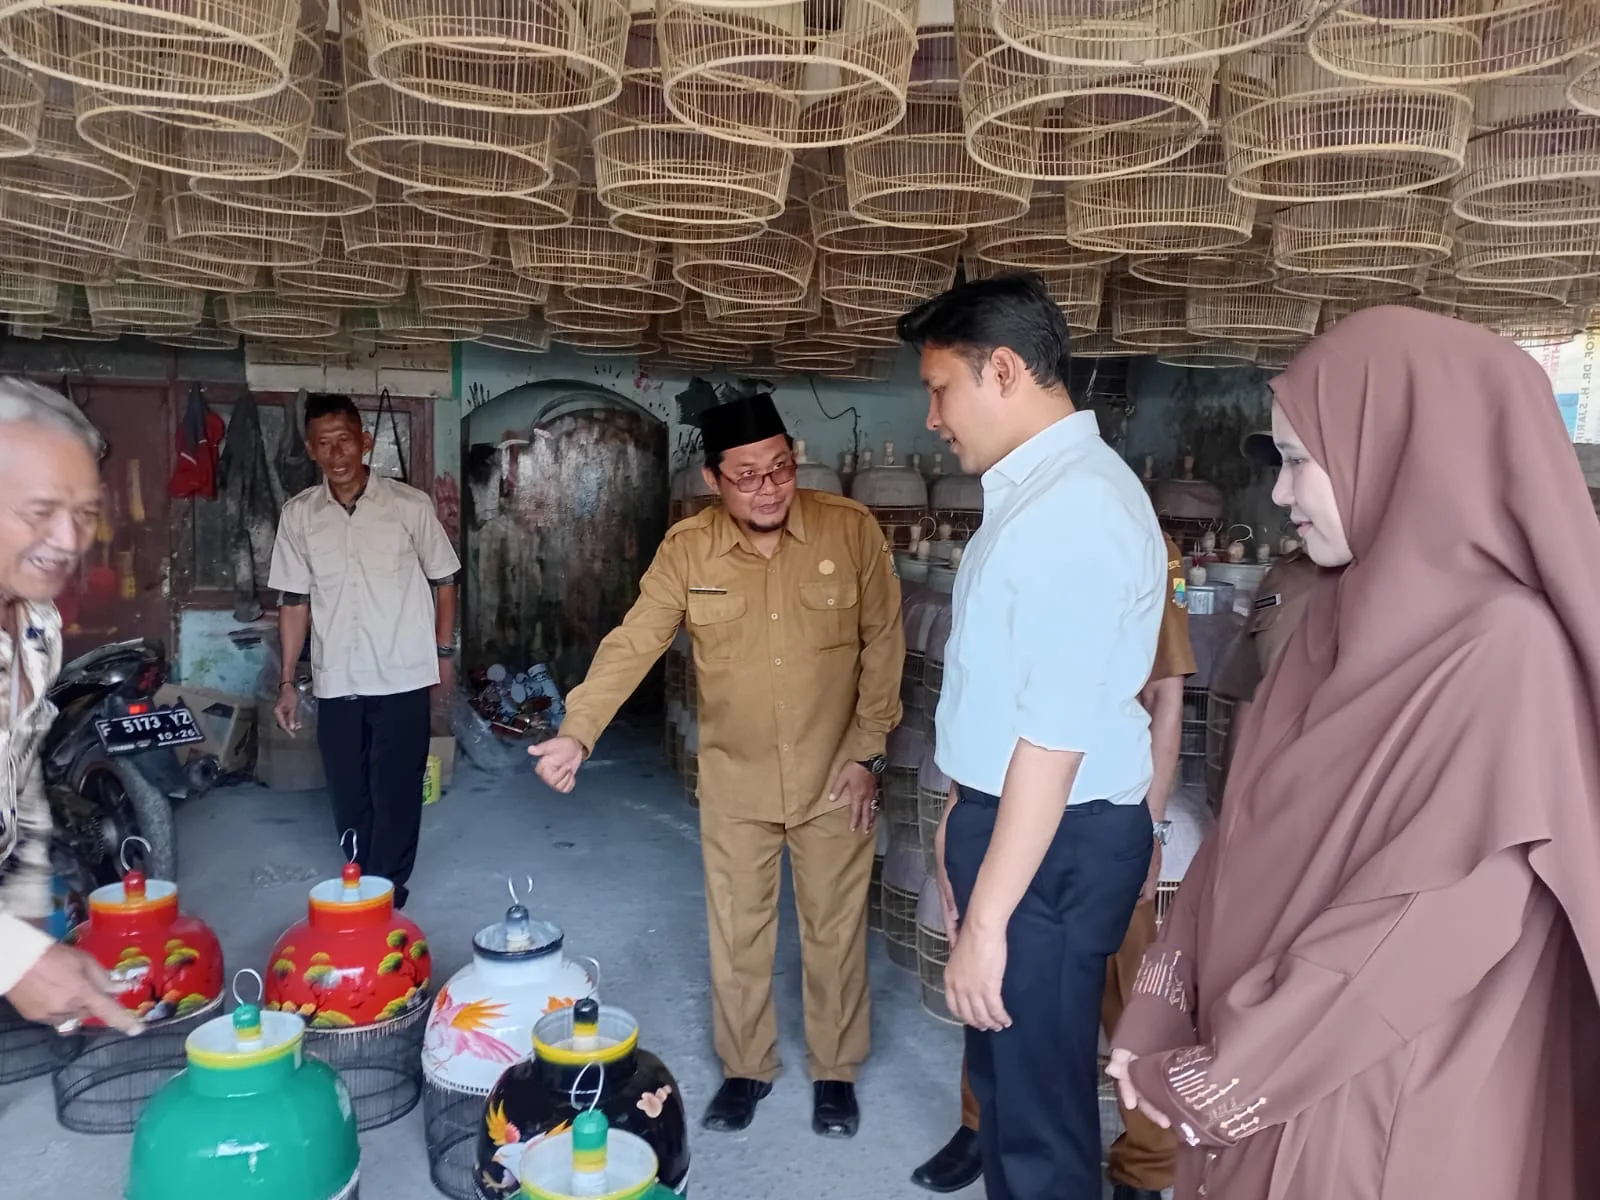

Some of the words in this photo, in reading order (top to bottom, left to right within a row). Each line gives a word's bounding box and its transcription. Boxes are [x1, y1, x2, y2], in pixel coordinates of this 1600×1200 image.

[100, 723, 112, 736] F
[122, 716, 161, 733] 5173
[169, 712, 191, 726] YZ
